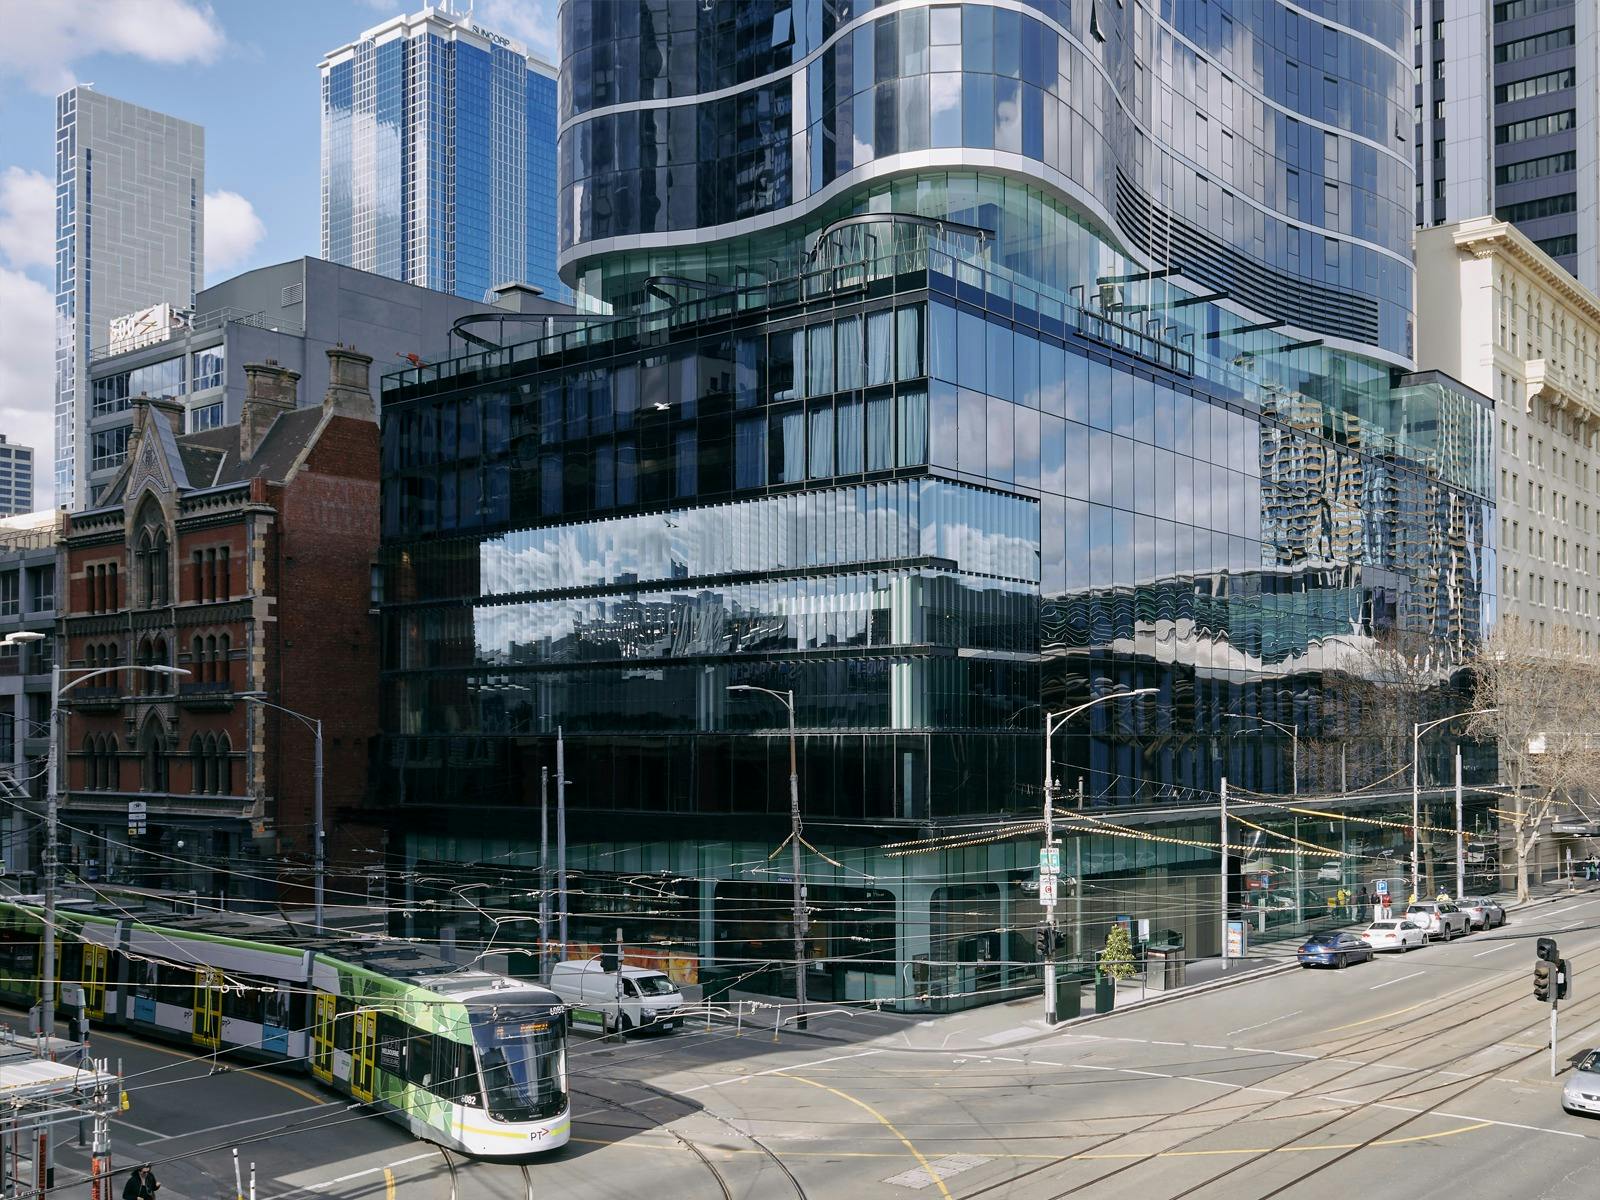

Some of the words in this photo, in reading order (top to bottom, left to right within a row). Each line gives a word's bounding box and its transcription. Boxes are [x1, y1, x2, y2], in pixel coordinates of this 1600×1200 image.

[473, 25, 510, 46] SUNCORP
[550, 1006, 565, 1016] 6082
[461, 1095, 476, 1105] 6082
